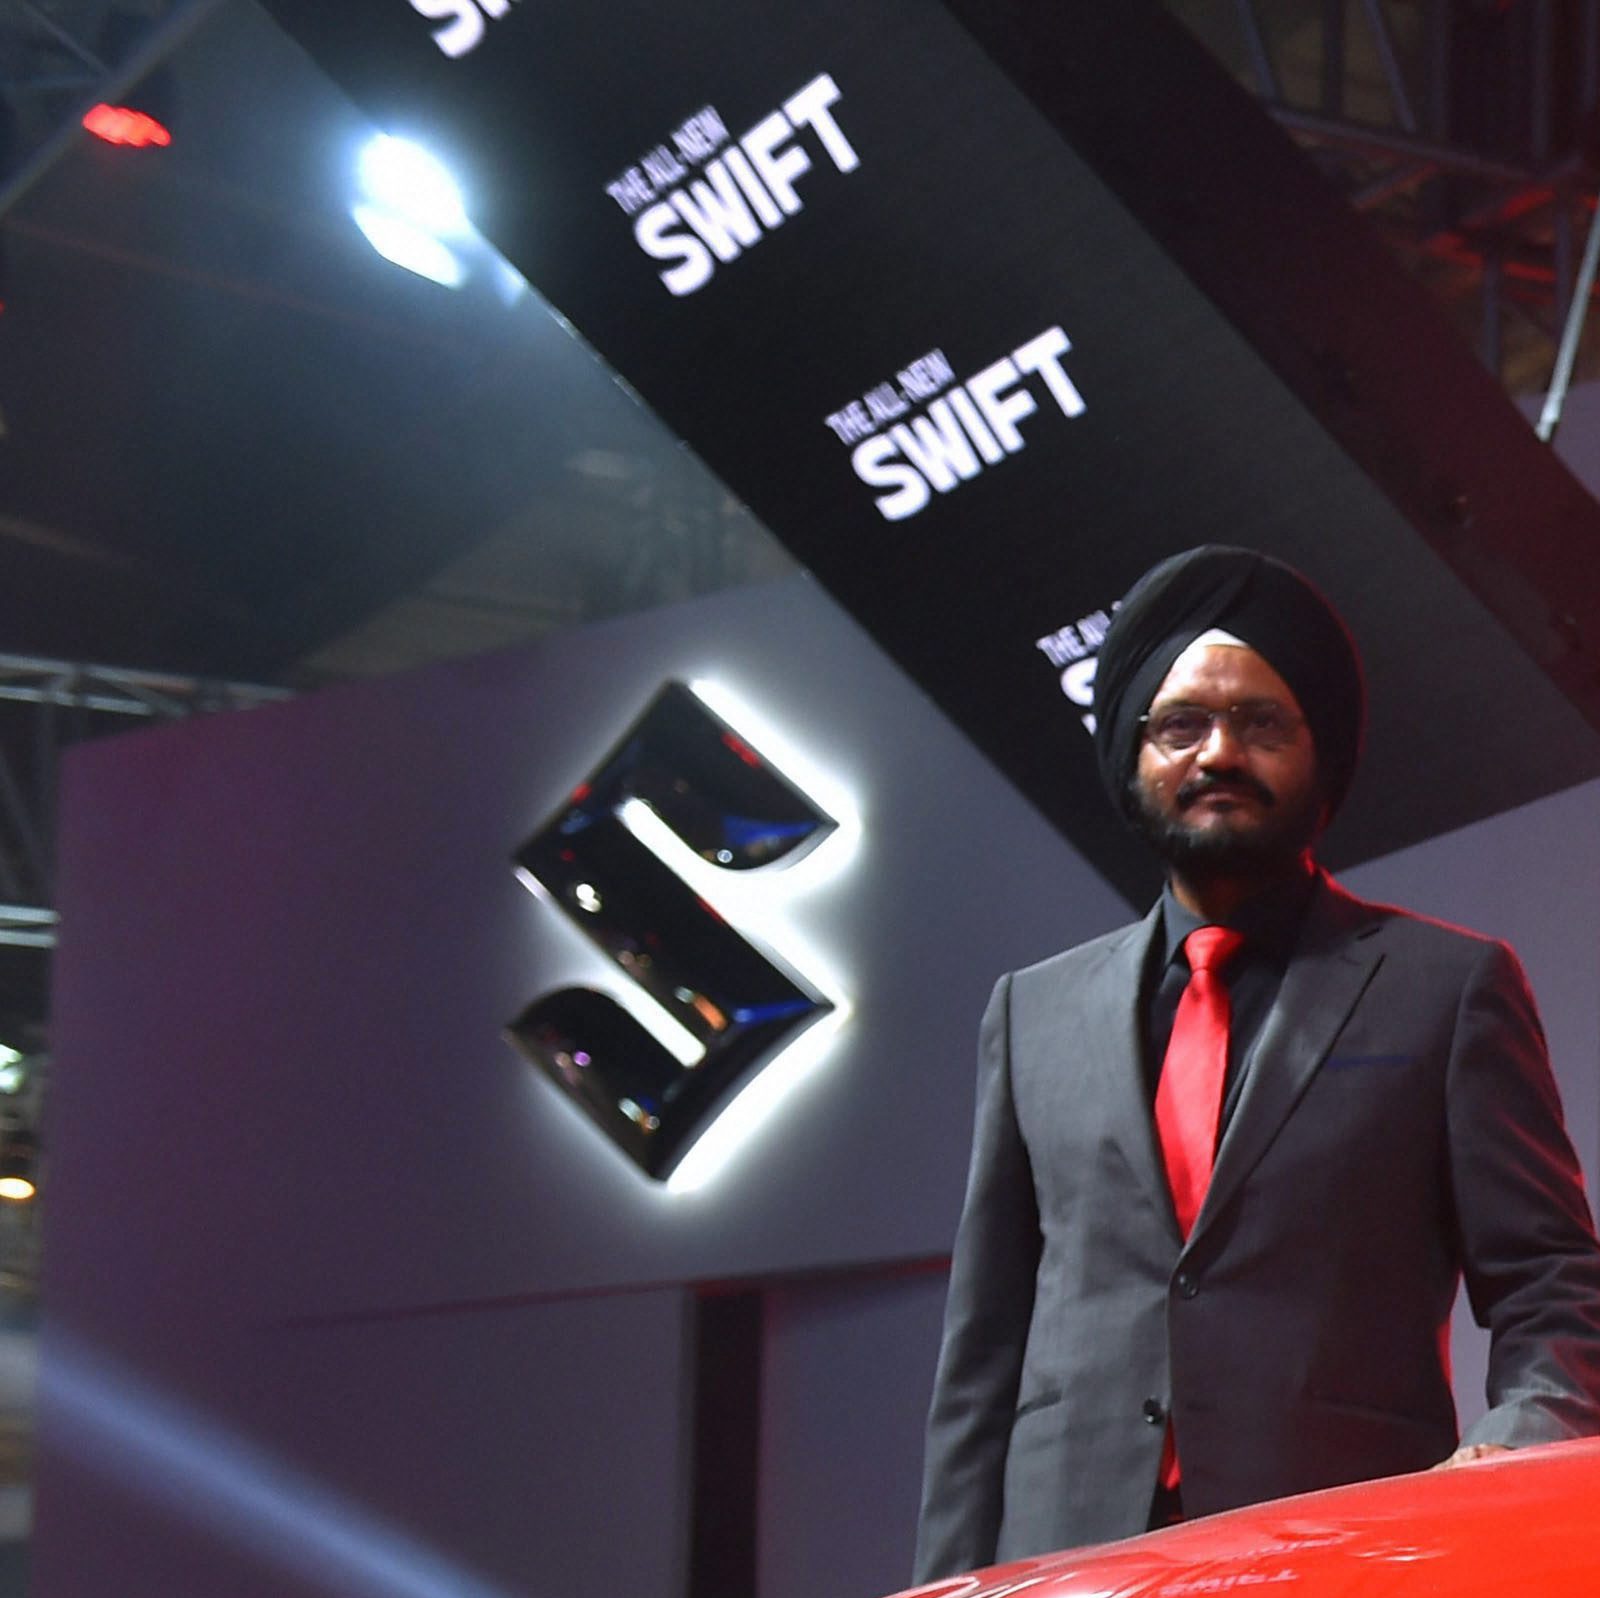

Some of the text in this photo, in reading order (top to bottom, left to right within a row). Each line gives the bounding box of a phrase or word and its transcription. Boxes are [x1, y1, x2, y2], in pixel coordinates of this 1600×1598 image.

[605, 104, 730, 216] THE ALL-NEW
[633, 71, 861, 297] SWIFT
[824, 347, 956, 447] THE ALL-NEW
[850, 325, 1088, 522] SWIFT
